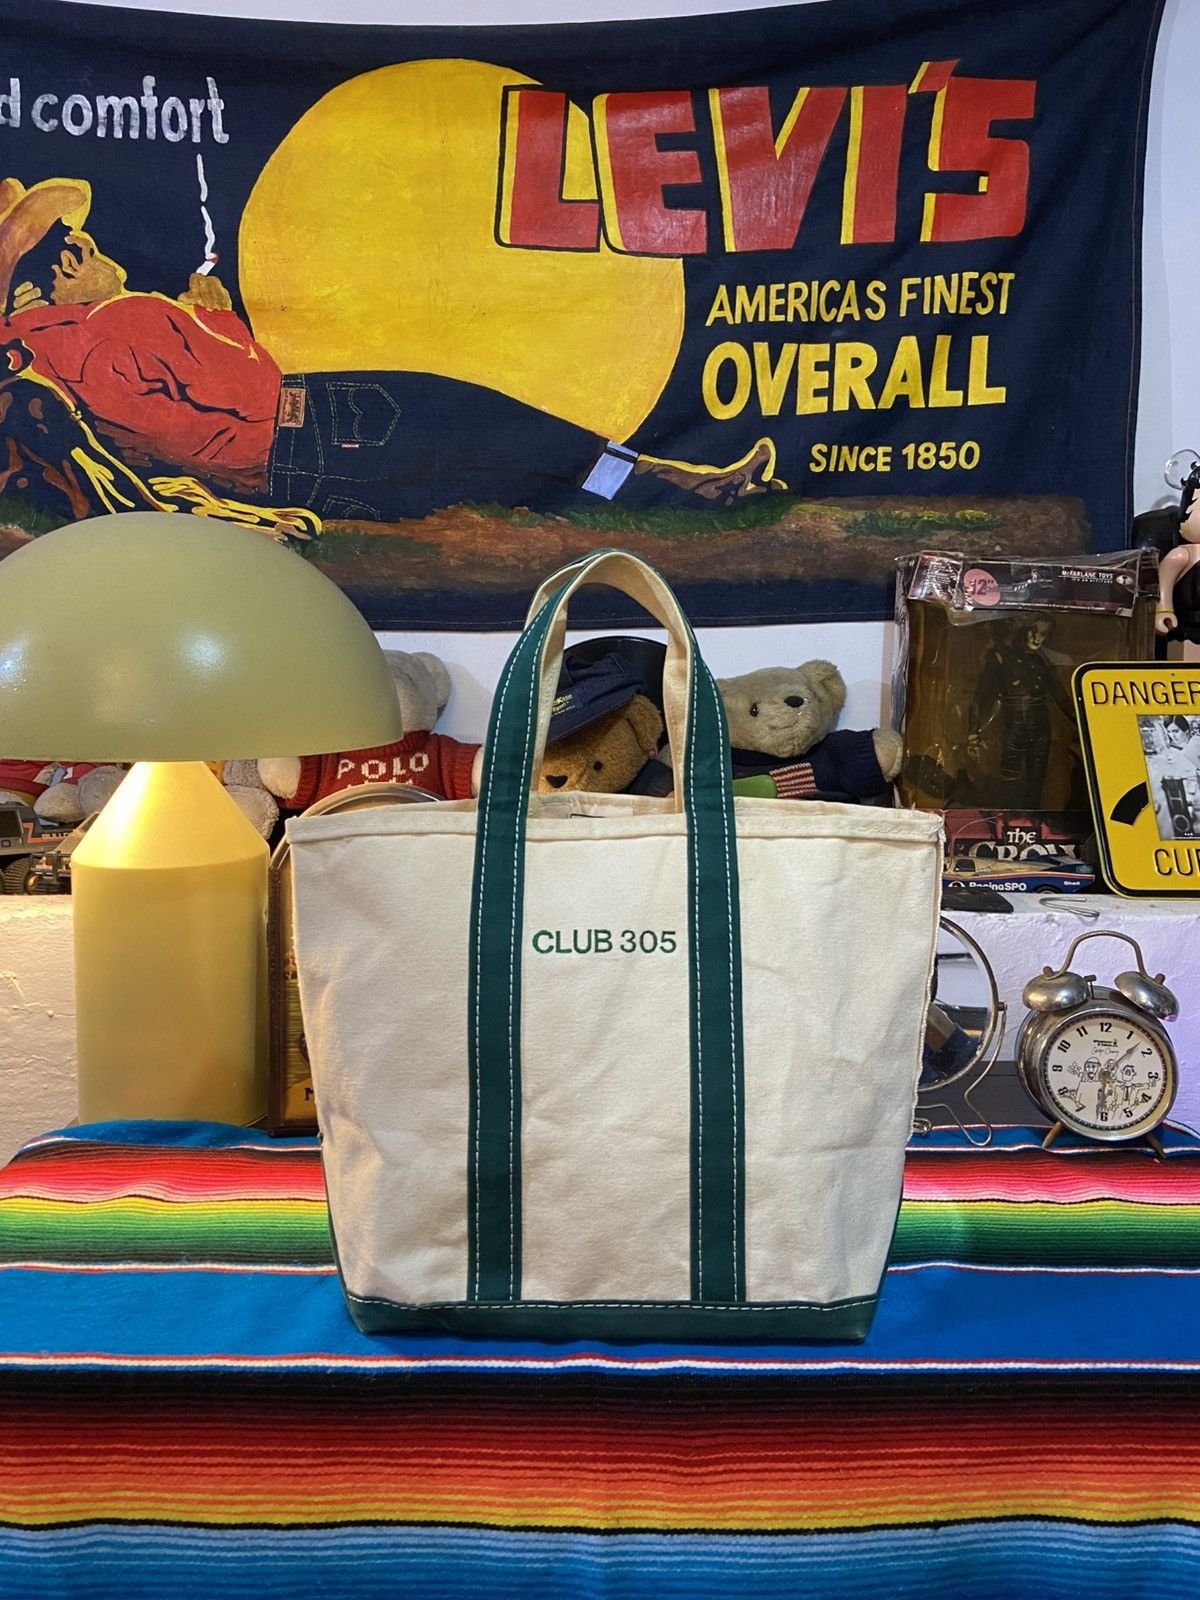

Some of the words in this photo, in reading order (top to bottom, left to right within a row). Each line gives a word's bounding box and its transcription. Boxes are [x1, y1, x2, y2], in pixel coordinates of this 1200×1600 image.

[31, 75, 230, 144] comfort
[495, 59, 1037, 257] LEVI'S
[899, 271, 1015, 317] FINEST
[702, 335, 1006, 420] OVERALL
[809, 443, 892, 473] SINCE
[902, 440, 980, 470] 1850
[1098, 572, 1113, 580] TOYS
[337, 752, 429, 779] POLO
[532, 928, 613, 954] CLUB
[620, 929, 677, 953] 305
[1076, 1025, 1088, 1037] 11
[1100, 1022, 1112, 1033] 12
[1126, 1030, 1134, 1040] 1
[1057, 1039, 1071, 1053] 10
[1141, 1048, 1153, 1058] 2
[1052, 1064, 1063, 1072] 9
[1147, 1071, 1159, 1080] 3
[1140, 1092, 1152, 1104] 4
[1100, 1111, 1108, 1122] 6
[1123, 1107, 1133, 1118] 5
